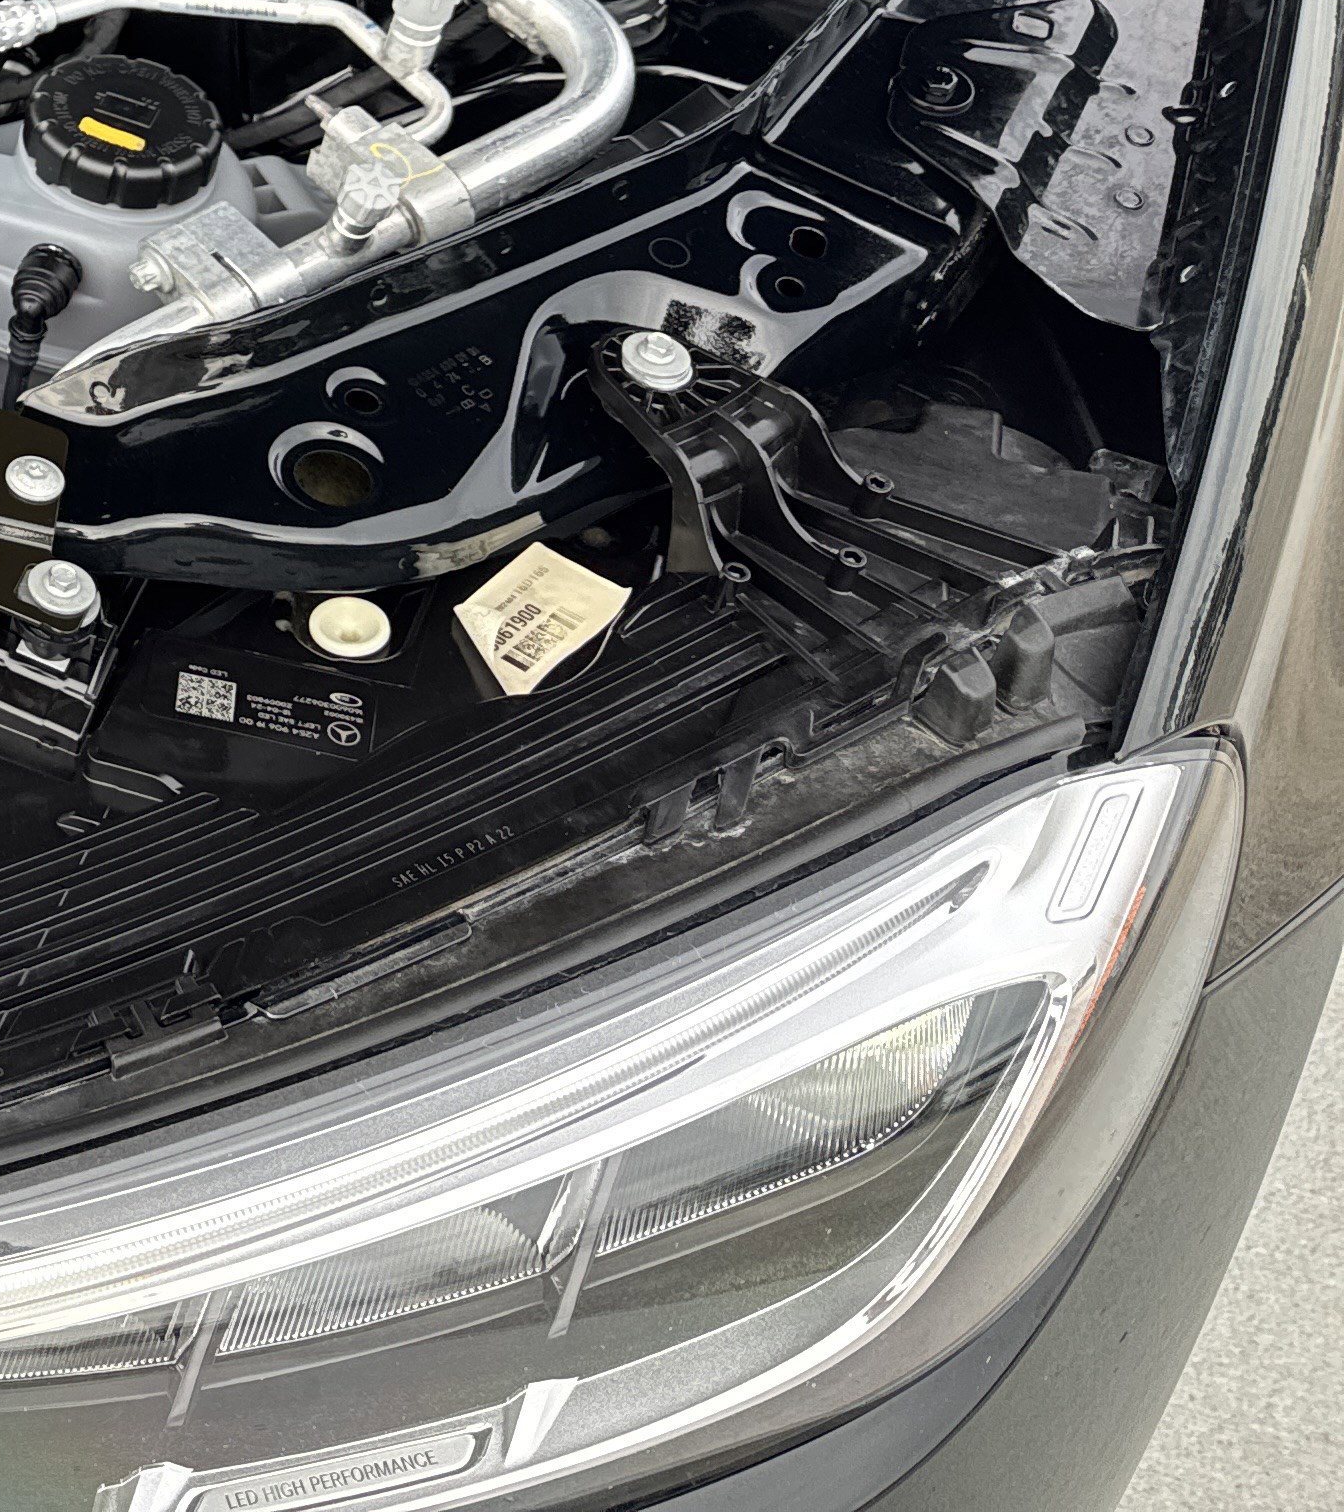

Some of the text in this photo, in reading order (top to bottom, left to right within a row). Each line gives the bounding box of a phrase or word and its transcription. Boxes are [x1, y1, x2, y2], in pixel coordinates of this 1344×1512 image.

[392, 869, 419, 888] SAE
[454, 847, 465, 859] P
[466, 839, 486, 854] P2
[484, 833, 497, 845] A
[495, 825, 515, 840] 22
[225, 1450, 439, 1510] LED HIGH PERFORMANCE
